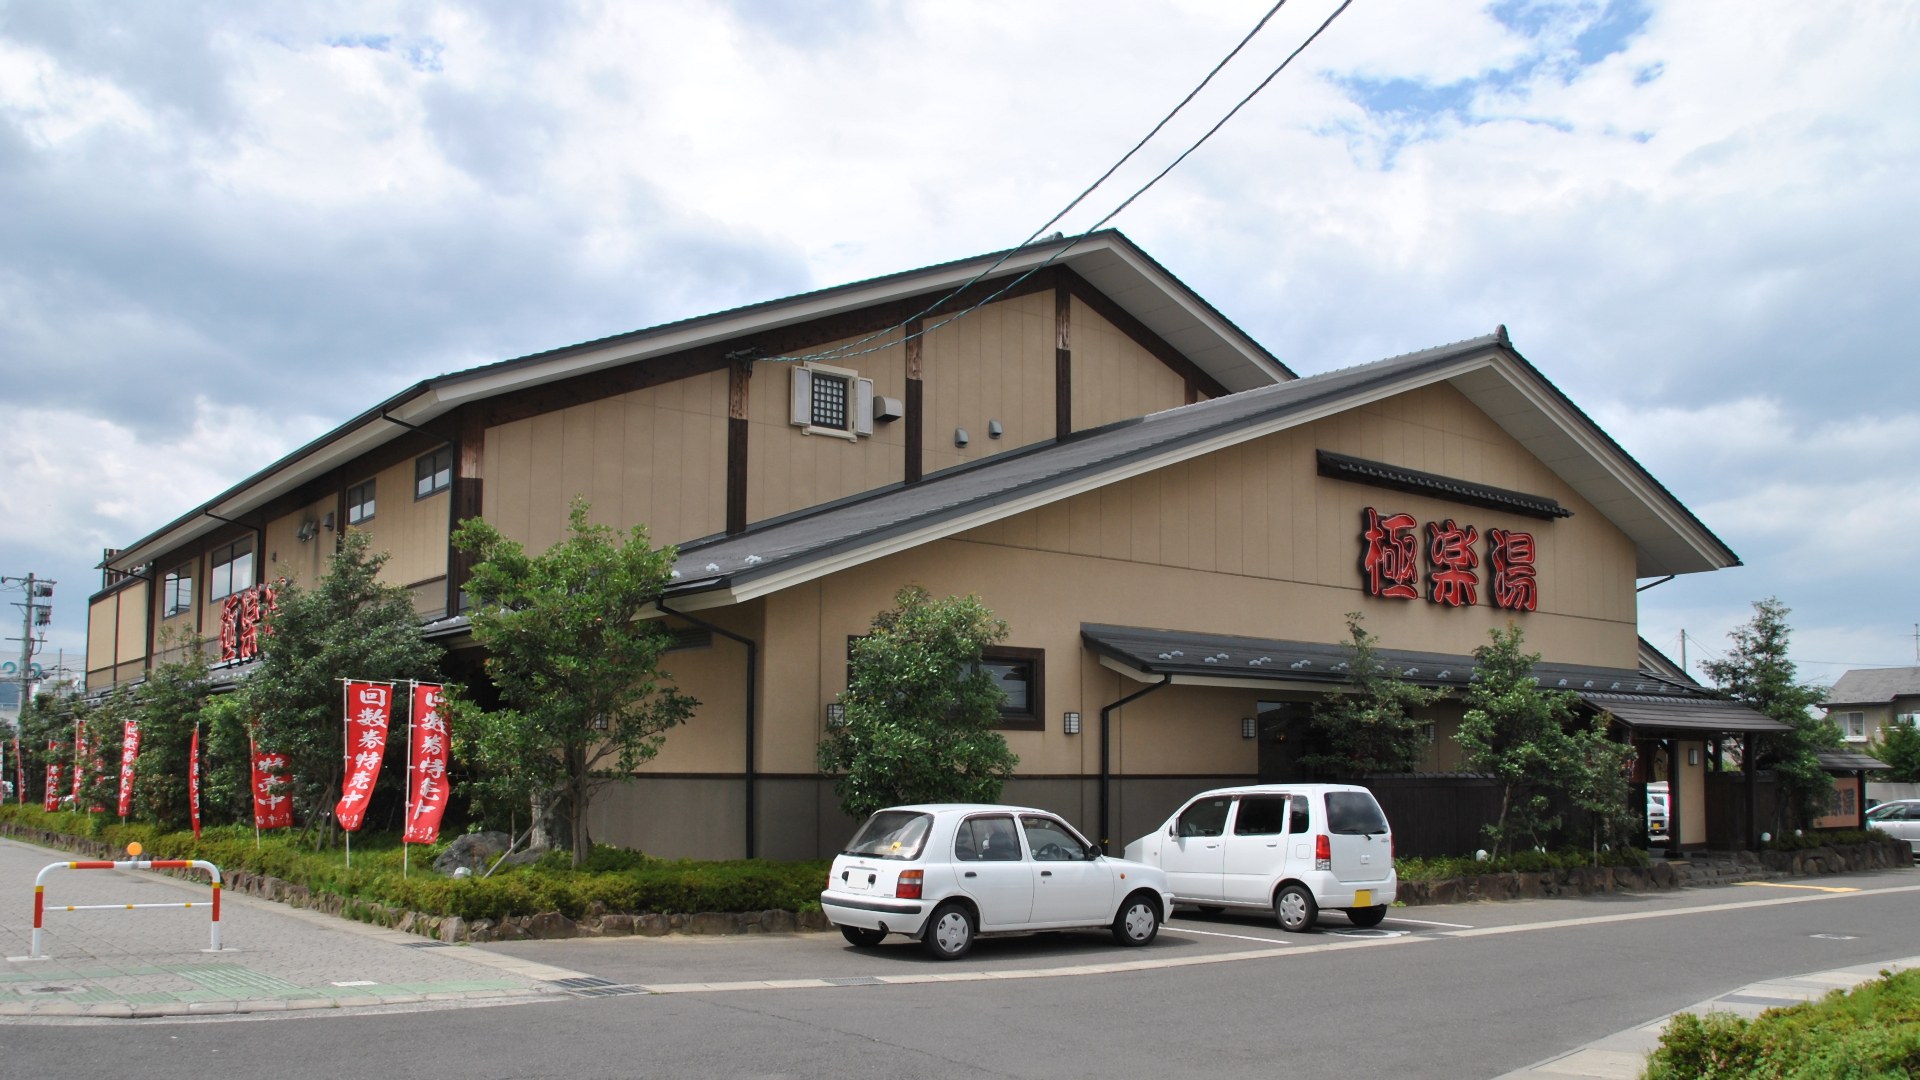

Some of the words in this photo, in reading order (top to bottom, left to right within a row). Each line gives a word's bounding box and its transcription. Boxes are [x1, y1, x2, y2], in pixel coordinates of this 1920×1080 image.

[1364, 507, 1537, 612] 極楽湯
[342, 688, 387, 809] 回数券特売中
